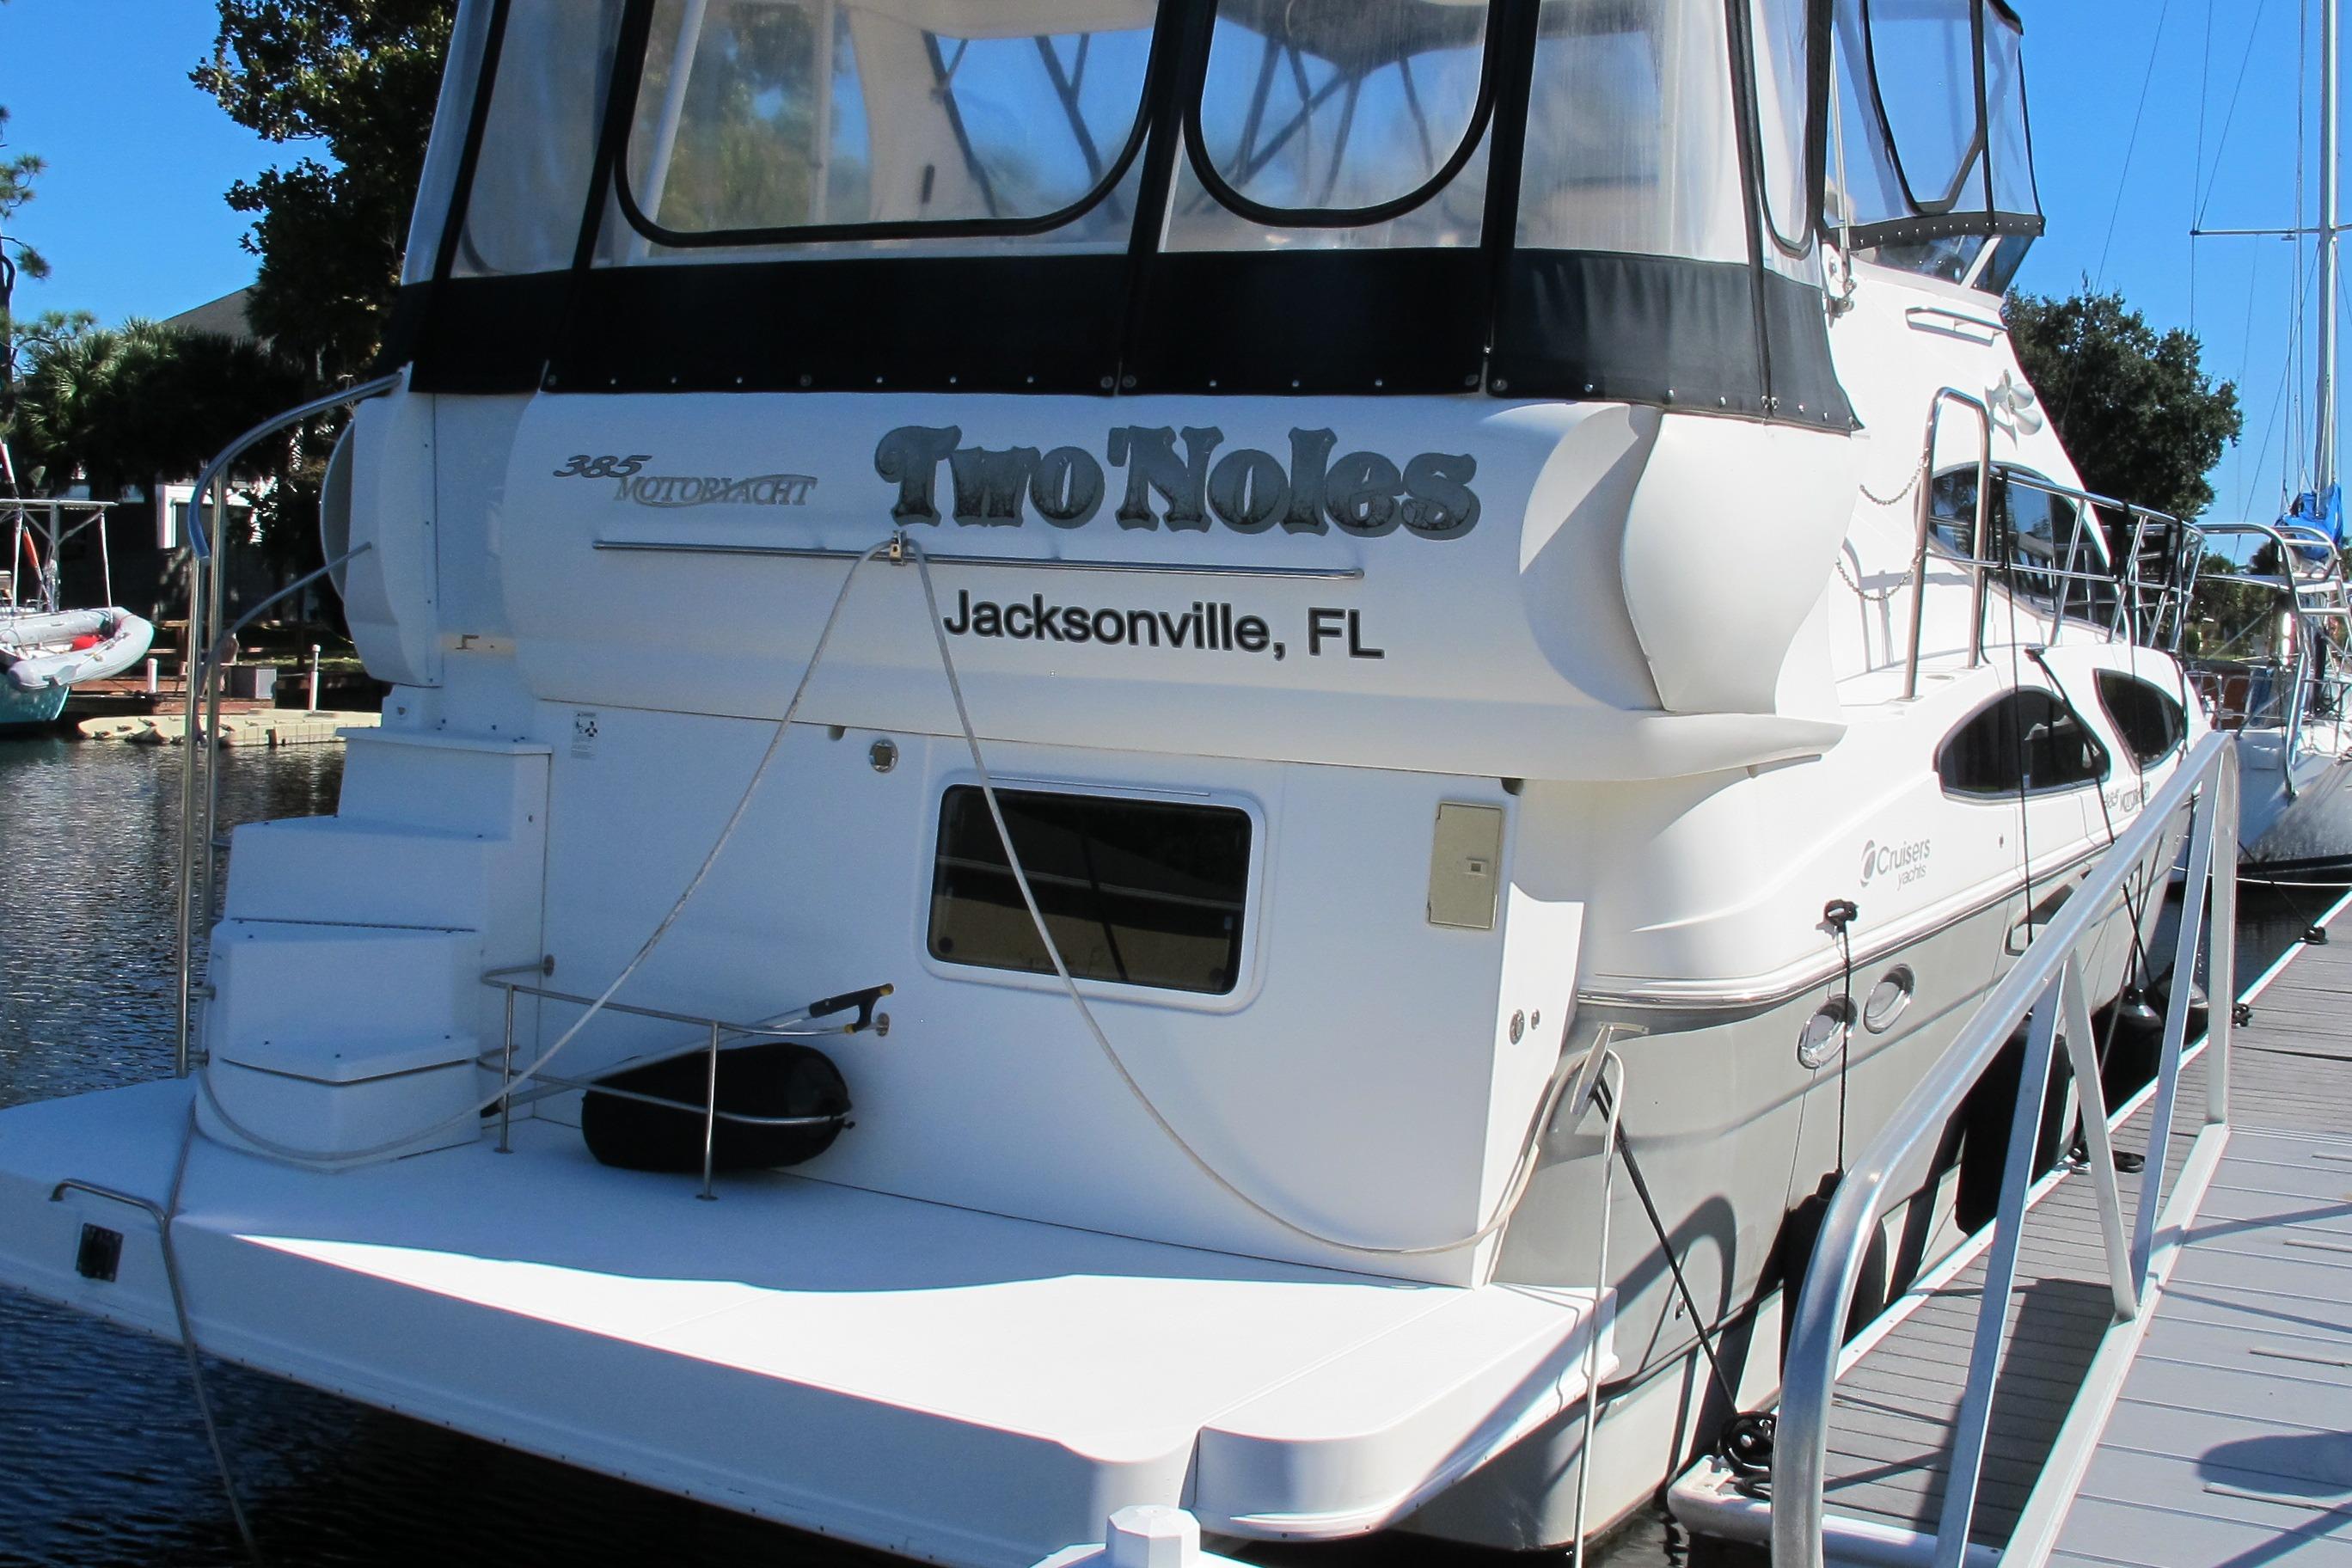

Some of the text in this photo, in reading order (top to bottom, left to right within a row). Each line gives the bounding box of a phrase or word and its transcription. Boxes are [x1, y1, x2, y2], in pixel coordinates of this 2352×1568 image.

[553, 455, 652, 478] 385
[874, 426, 1481, 540] Two Noles
[613, 474, 818, 507] MOTORYACHT
[944, 589, 1385, 661] Jacksonville, FL
[1877, 839, 1931, 875] Cruisers
[1896, 864, 1926, 891] yachts
